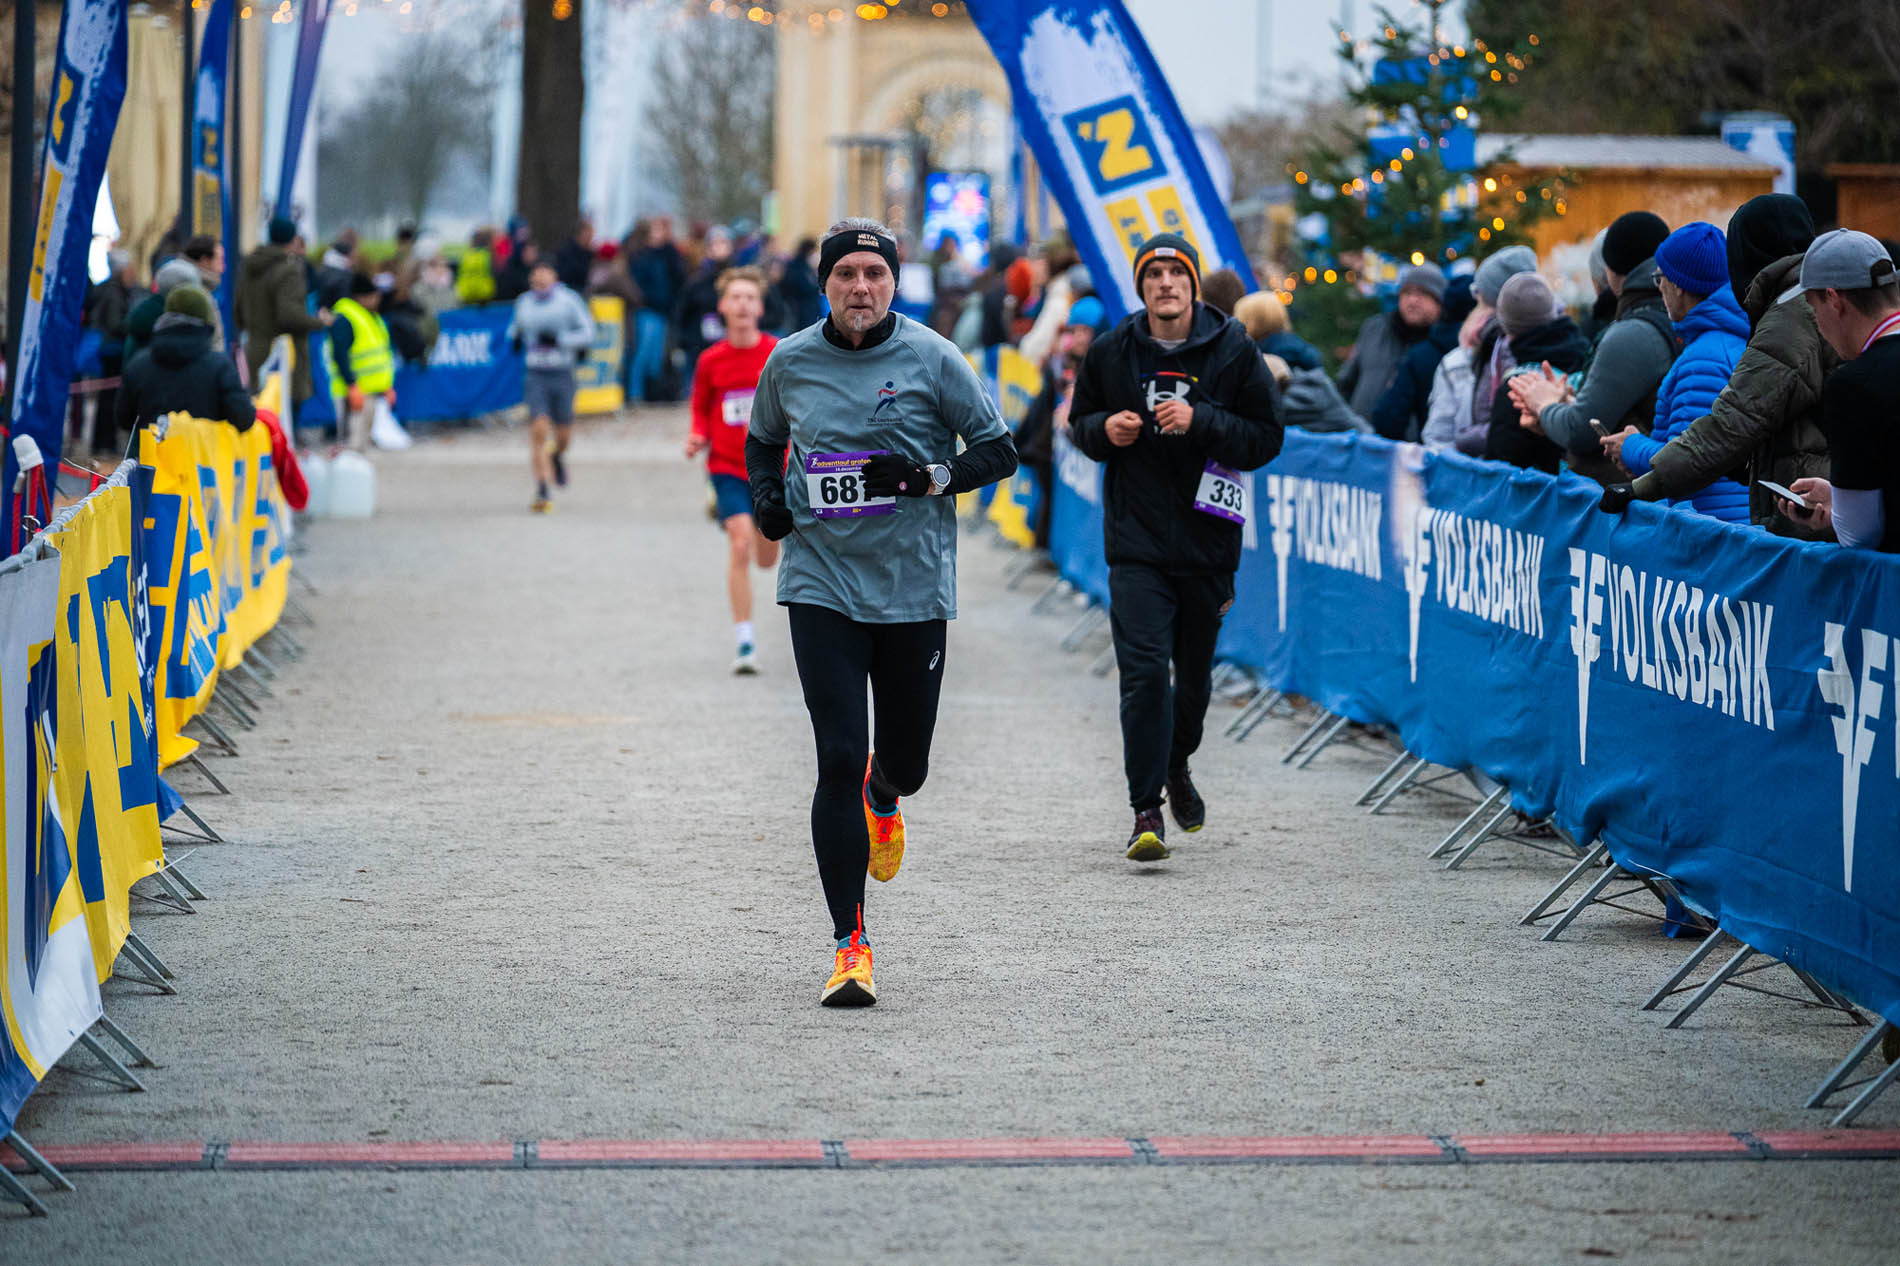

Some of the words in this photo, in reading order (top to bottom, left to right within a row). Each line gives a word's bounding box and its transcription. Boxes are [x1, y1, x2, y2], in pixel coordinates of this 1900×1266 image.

[857, 239, 880, 248] RUNNER
[858, 233, 877, 241] METAL
[1209, 479, 1243, 511] 333
[1294, 476, 1383, 582] VOLKSBANK
[1432, 508, 1545, 640] VOLKSBANK
[1607, 559, 1775, 731] VOLKSBANK
